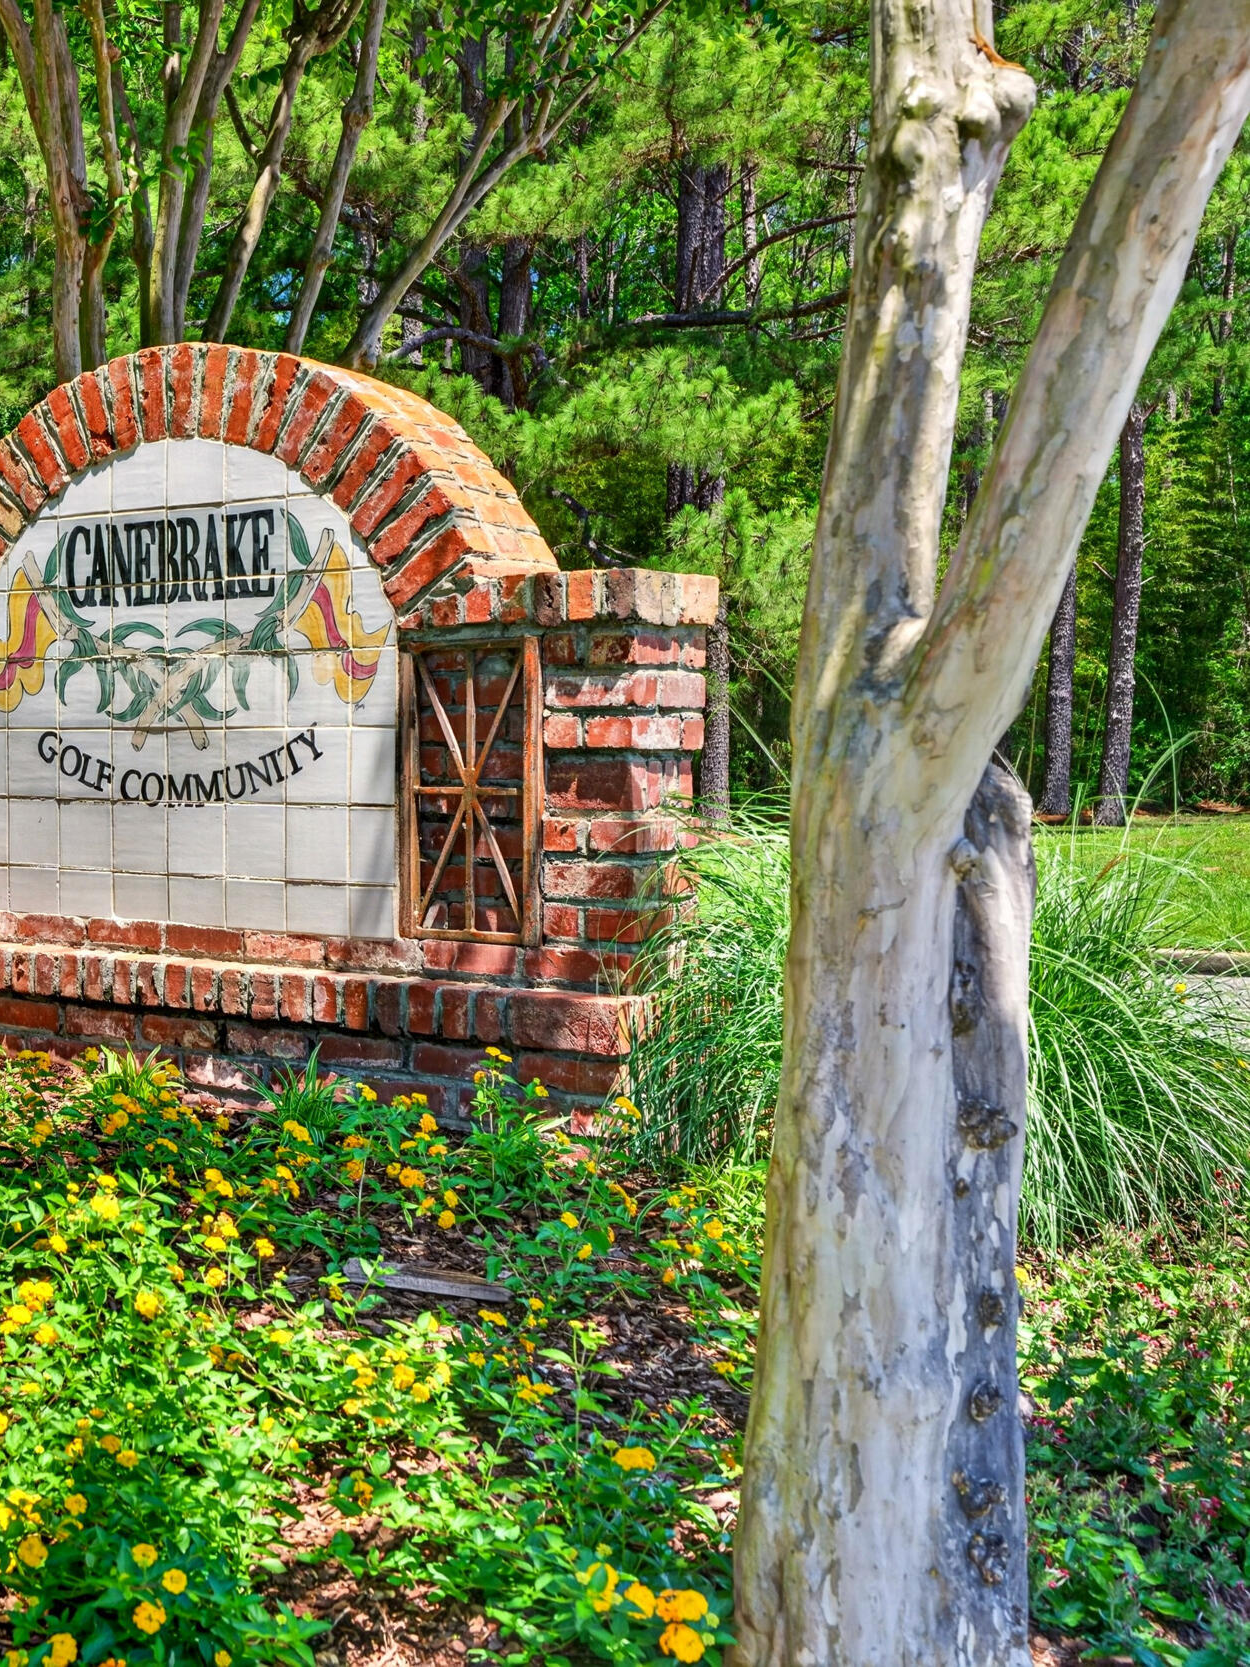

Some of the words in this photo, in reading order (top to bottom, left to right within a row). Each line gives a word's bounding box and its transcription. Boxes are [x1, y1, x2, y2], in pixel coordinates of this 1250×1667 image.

[65, 508, 276, 608] CANEBRAKE
[37, 730, 116, 793] GOLF
[120, 721, 324, 807] COMMUNITY
